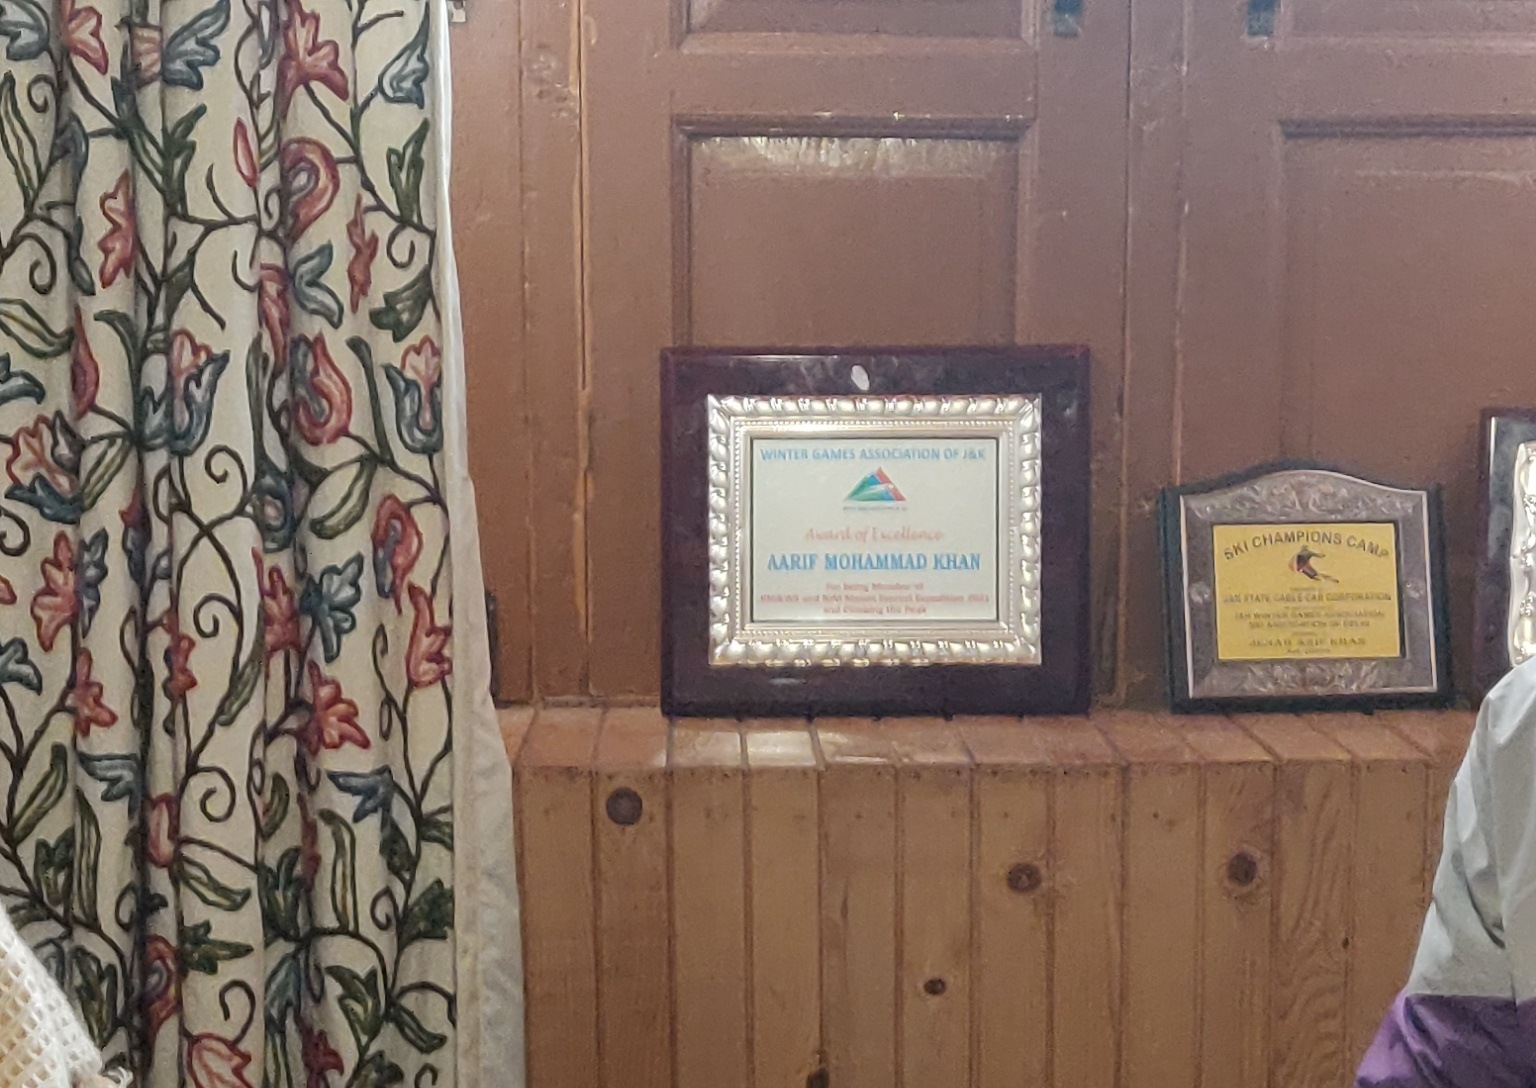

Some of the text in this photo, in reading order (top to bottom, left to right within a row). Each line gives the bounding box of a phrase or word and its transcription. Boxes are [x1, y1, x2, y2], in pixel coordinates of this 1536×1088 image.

[760, 448, 808, 460] WINTER
[812, 448, 855, 460] GAMES
[860, 448, 940, 460] ASSOCIATION
[944, 448, 959, 460] OF
[1224, 531, 1389, 560] SKI CHAMPIONS CAMP
[767, 553, 981, 570] AARIF MOHAMMAD KHAN
